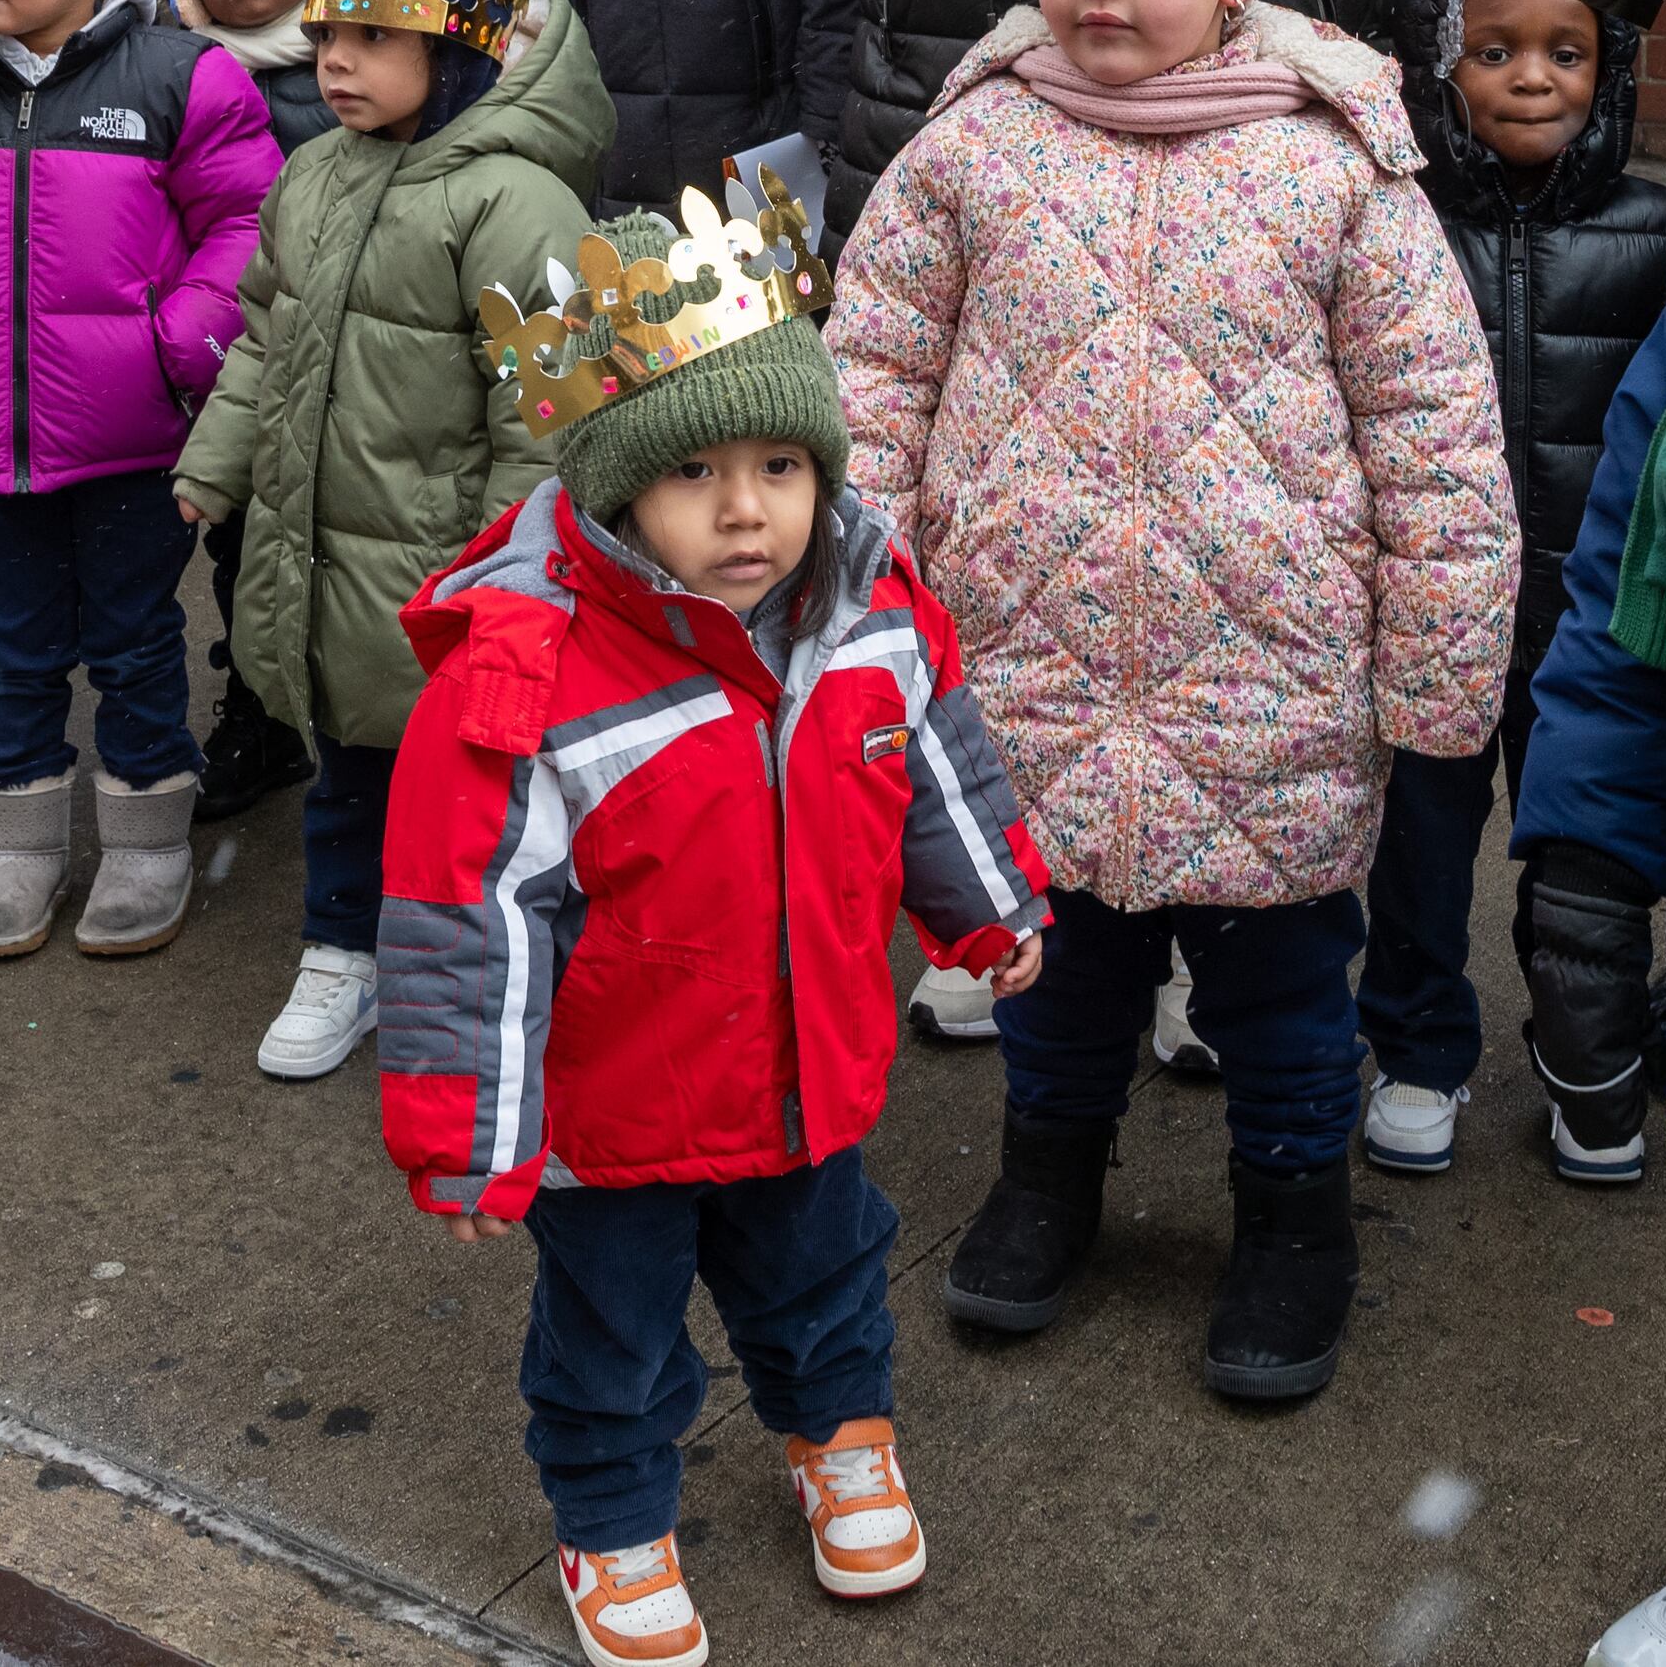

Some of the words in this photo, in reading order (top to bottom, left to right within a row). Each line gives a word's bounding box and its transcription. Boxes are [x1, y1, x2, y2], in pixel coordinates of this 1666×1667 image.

[100, 107, 125, 119] THE
[80, 116, 125, 129] NORTH
[92, 127, 124, 139] FACE
[646, 326, 721, 371] EDWIN
